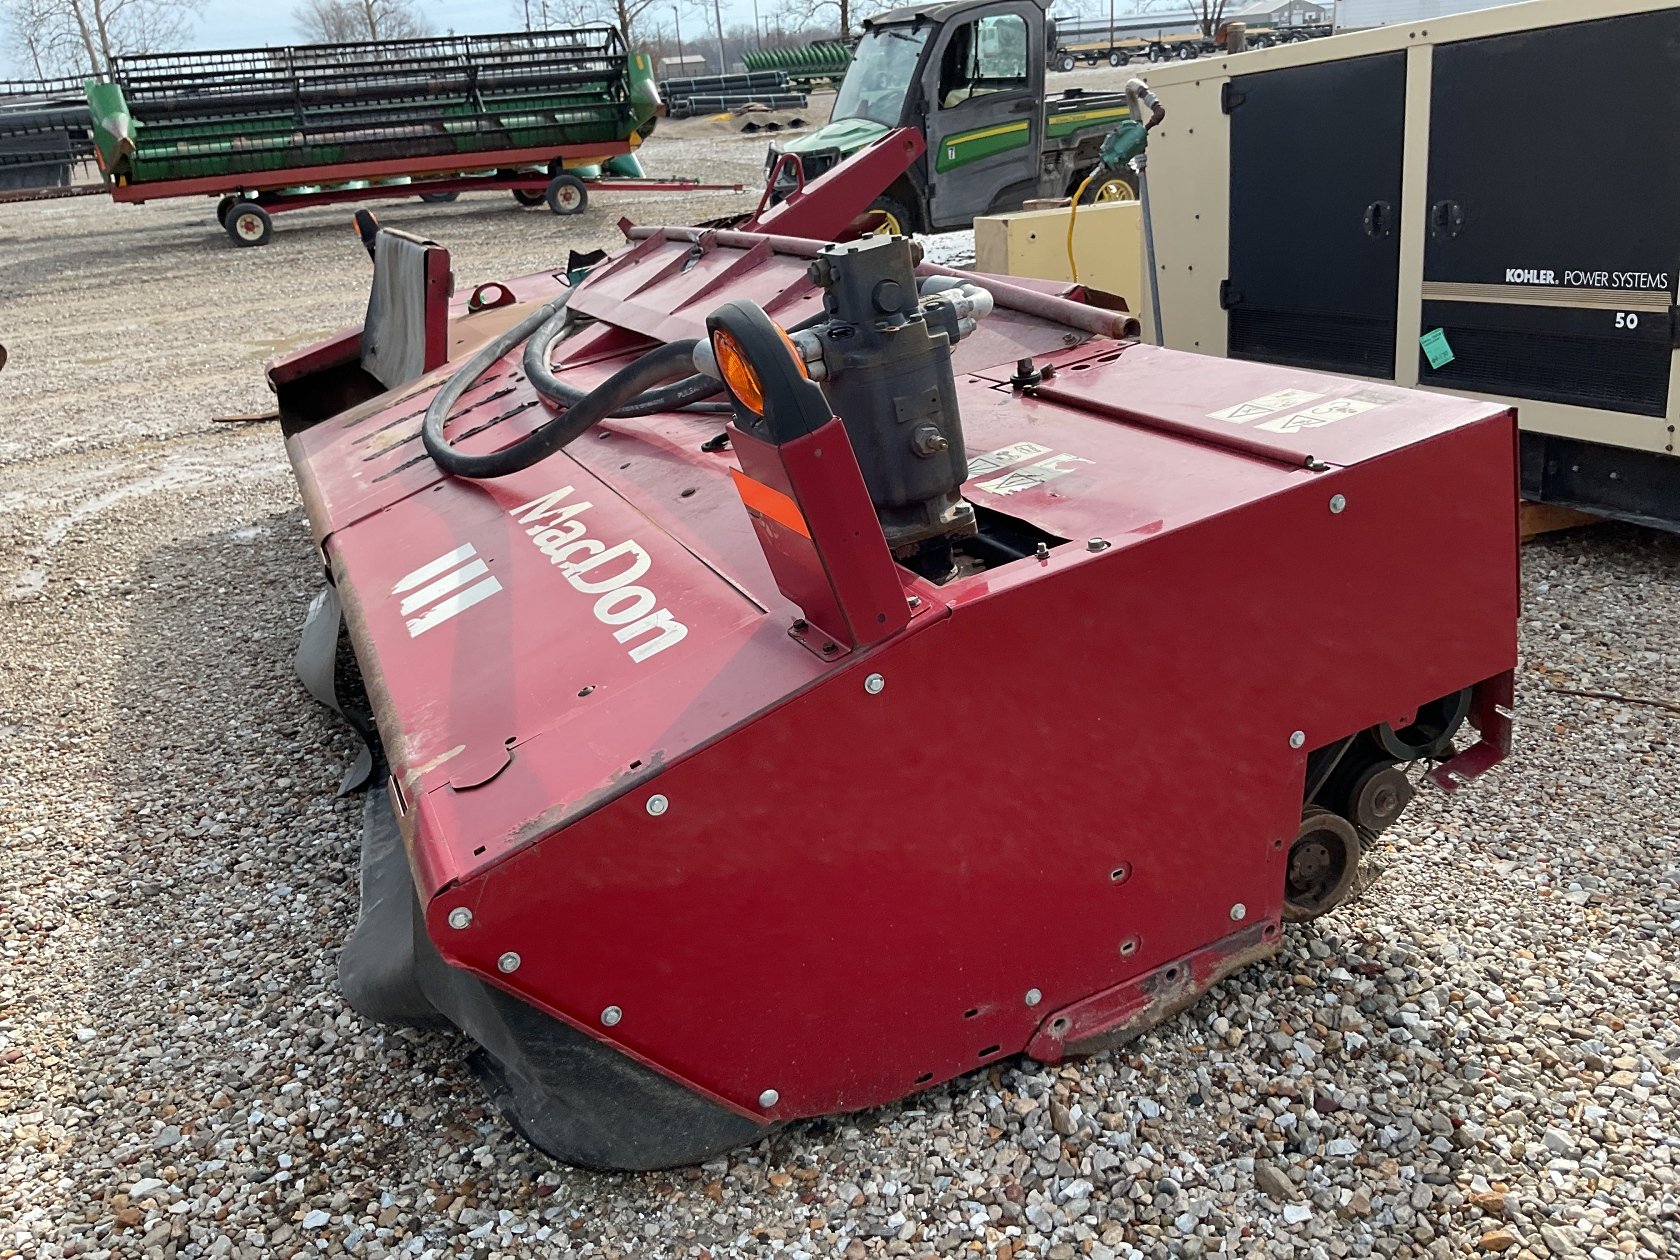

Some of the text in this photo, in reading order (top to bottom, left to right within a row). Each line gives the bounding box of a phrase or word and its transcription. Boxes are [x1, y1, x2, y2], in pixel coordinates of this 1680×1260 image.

[1564, 270, 1609, 287] POWER
[1611, 271, 1668, 289] SYSTEMS
[1615, 312, 1639, 330] 50
[508, 484, 689, 664] MacDon
